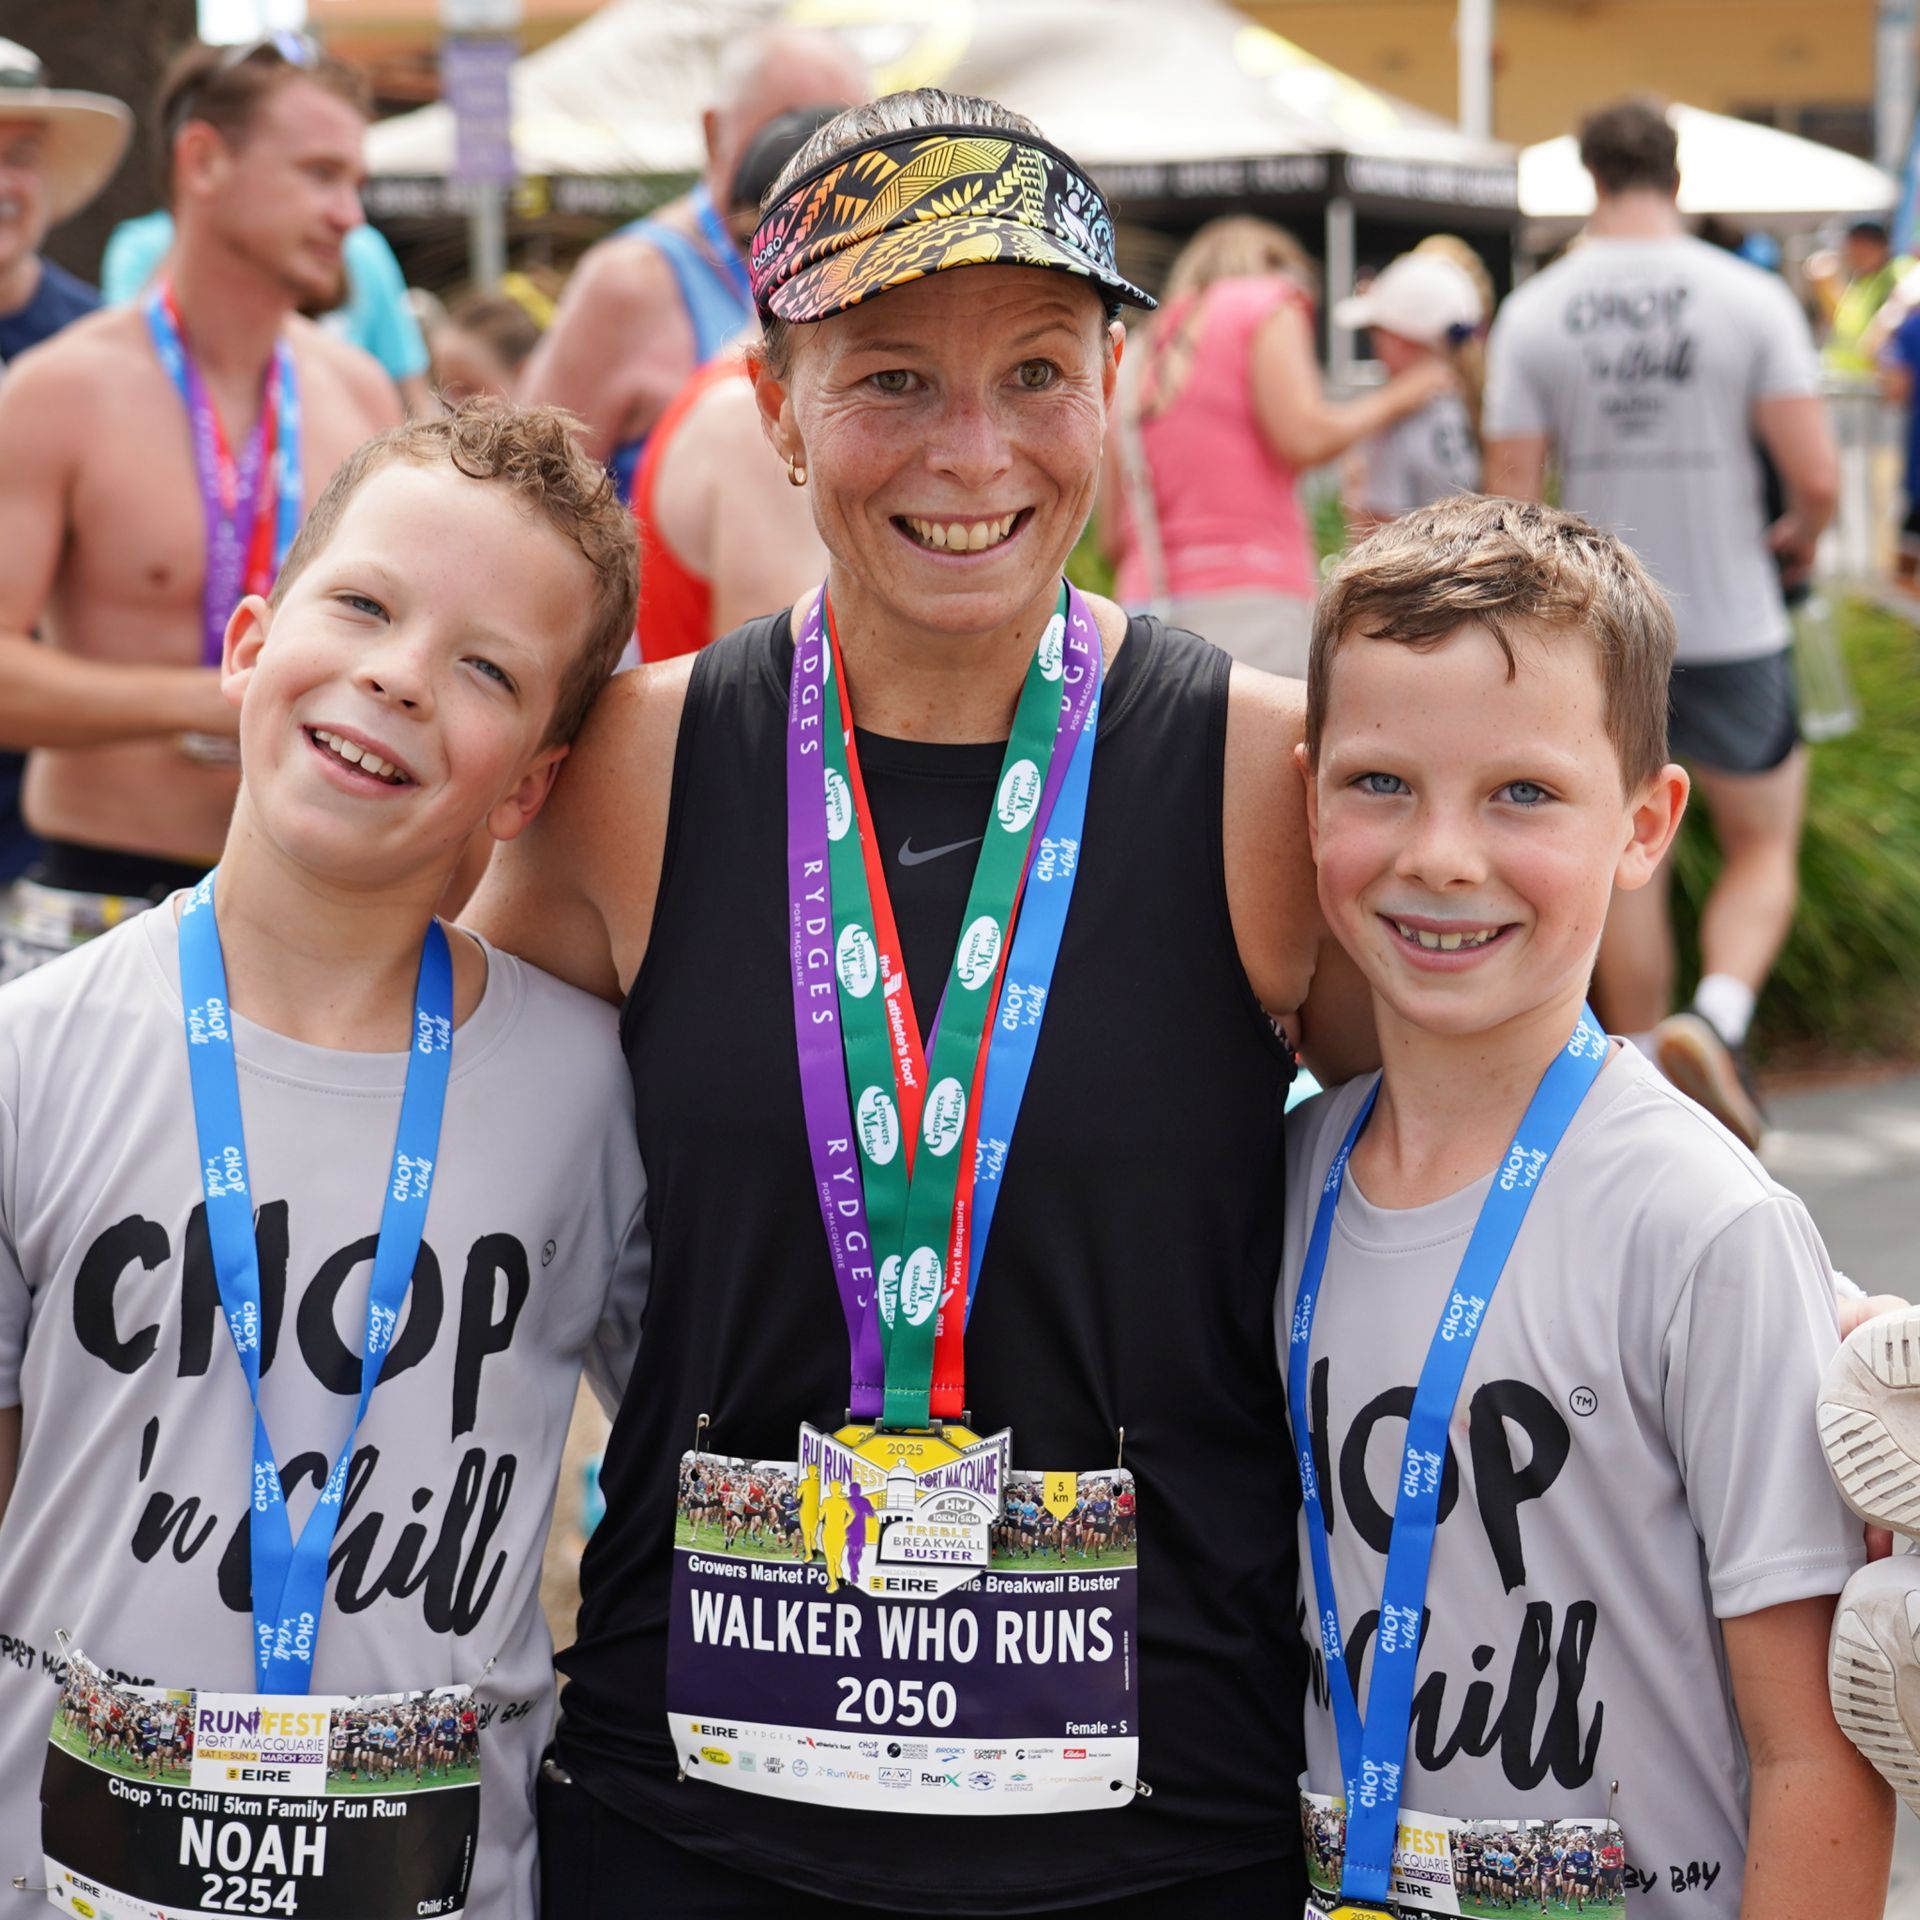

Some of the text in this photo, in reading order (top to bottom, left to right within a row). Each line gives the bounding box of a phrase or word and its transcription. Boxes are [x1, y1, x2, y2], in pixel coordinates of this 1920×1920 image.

[752, 236, 782, 271] boco
[800, 603, 820, 755] RYDGES
[1070, 710, 1083, 730] PORT
[1079, 658, 1098, 709] MACQUARIE
[827, 772, 844, 822] Growers
[999, 775, 1021, 824] Growers
[1015, 771, 1040, 815] Market
[1037, 837, 1059, 882] CHOP
[794, 935, 805, 987] MACQUARIE
[804, 859, 834, 1024] RYDGES
[852, 926, 870, 979] Growers
[958, 932, 981, 983] Growers
[975, 927, 999, 970] Market
[841, 947, 856, 990] Market
[206, 997, 228, 1040] CHOP
[880, 954, 915, 1086] the athlete's foot
[1002, 983, 1027, 1031] CHOP
[417, 1011, 435, 1054] CHOP
[1568, 1020, 1594, 1057] CHOP
[862, 1110, 877, 1157] Market
[873, 1092, 891, 1145] Growers
[924, 1095, 945, 1149] Growers
[941, 1088, 962, 1135] Market
[223, 1146, 246, 1193] CHOP
[393, 1154, 416, 1202] CHOP
[1500, 1145, 1530, 1190] CHOP
[821, 1182, 845, 1269] PORT MACQUARIE
[951, 1200, 965, 1285] Port Macquarie
[902, 1265, 921, 1317] Growers
[918, 1257, 939, 1304] Market
[73, 1199, 530, 1444] CHOP
[243, 1301, 258, 1348] CHOP
[368, 1305, 385, 1354] CHOP
[1299, 1294, 1311, 1340] CHOP
[1441, 1293, 1469, 1341] CHOP
[887, 1443, 924, 1456] 2025
[1404, 1448, 1425, 1498] CHOP
[254, 1463, 268, 1512] CHOP
[919, 1470, 942, 1488] PORT
[1053, 1492, 1069, 1503] km
[1057, 1482, 1064, 1492] 5
[1303, 1451, 1316, 1498] CHOP
[132, 1416, 517, 1636] 'n Chill
[944, 1500, 969, 1510] HM
[893, 1536, 984, 1550] BREAKWALL
[904, 1548, 973, 1560] BUSTER
[906, 1525, 971, 1537] TREBLE
[688, 1555, 748, 1578] Growers
[751, 1564, 803, 1584] Market
[807, 1568, 828, 1585] Po
[985, 1576, 1064, 1594] Breakwall
[1068, 1575, 1120, 1592] Buster
[886, 1577, 938, 1593] EIRE
[291, 1611, 314, 1661] CHOP
[690, 1588, 862, 1658] WALKER
[877, 1604, 979, 1664] WHO
[996, 1607, 1113, 1664] RUNS
[1326, 1610, 1340, 1658] CHOP
[1381, 1604, 1402, 1653] CHOP
[835, 1676, 957, 1728] 2050
[198, 1735, 325, 1751] PORT MACQUARIE
[701, 1724, 739, 1739] EIRE
[1066, 1720, 1128, 1734] Female S
[199, 1750, 323, 1763] SAT SUN 2 MARCH 2025
[935, 1747, 966, 1755] BROOKS
[241, 1769, 291, 1782] EIRE
[1360, 1760, 1382, 1808] CHOP
[108, 1778, 408, 1821] Chop 'n Chill 5km Family Fun Run
[179, 1815, 328, 1877] NOAH
[72, 1876, 101, 1898] EIRE
[200, 1873, 298, 1916] 2254
[1395, 1881, 1433, 1899] EIRE
[1404, 1870, 1430, 1880] MARCH
[1431, 1874, 1450, 1883] 2025
[1670, 1861, 1721, 1893] BAY
[417, 1898, 442, 1915] Child
